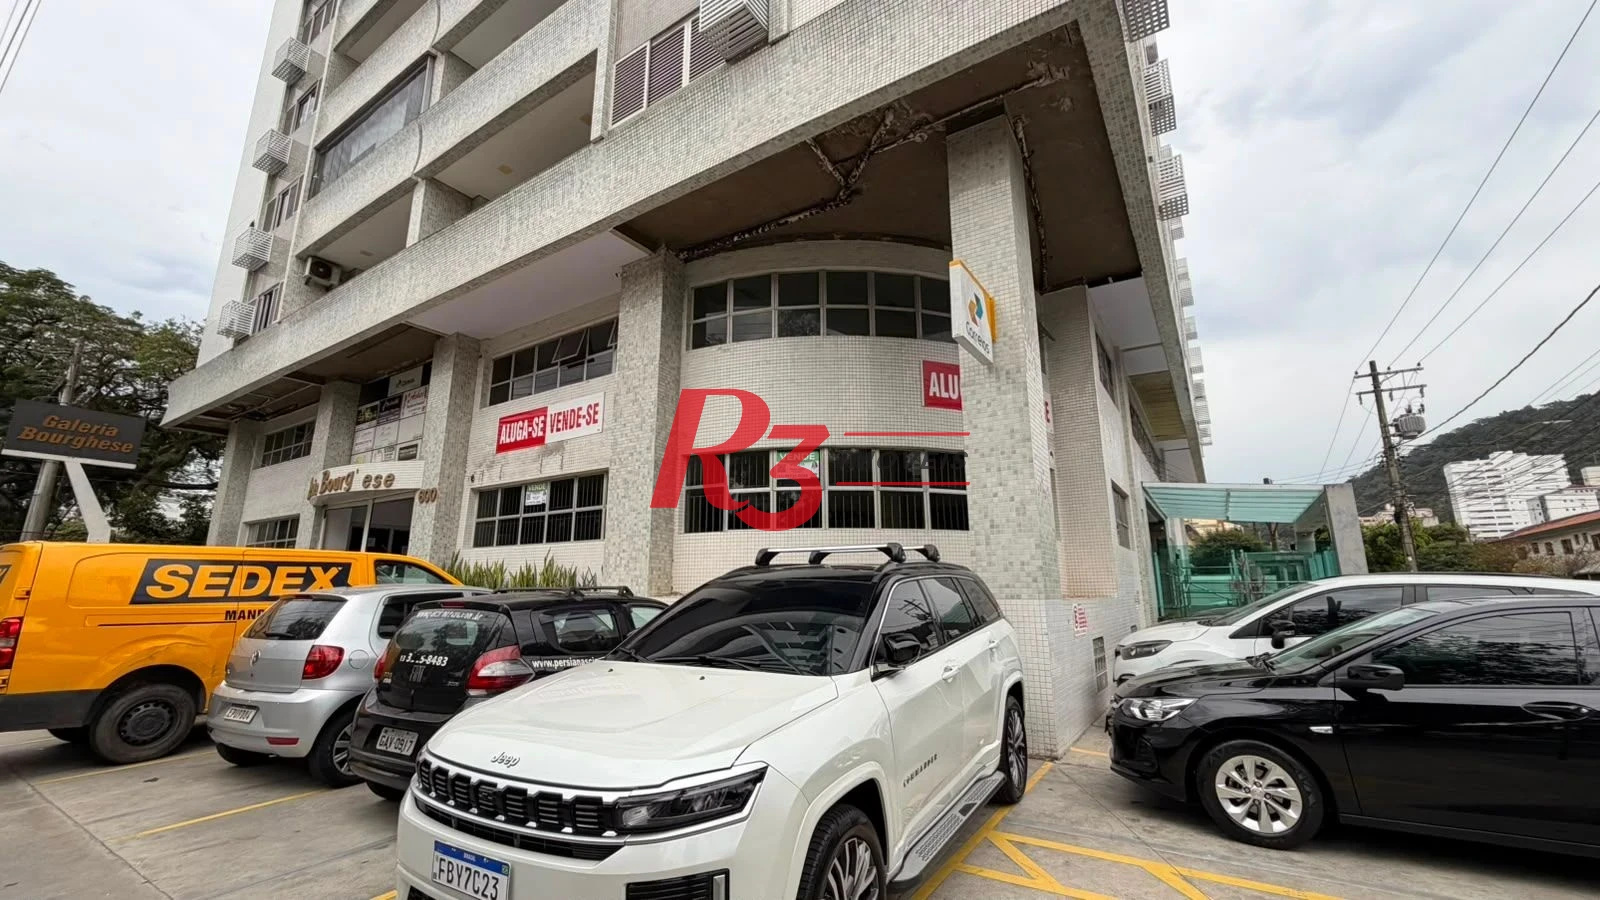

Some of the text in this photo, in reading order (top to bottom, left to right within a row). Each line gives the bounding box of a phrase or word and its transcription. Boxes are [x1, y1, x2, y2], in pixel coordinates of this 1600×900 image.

[929, 371, 963, 399] ALU
[43, 415, 119, 437] Galeria
[500, 416, 545, 445] ALUGA-SE
[550, 402, 600, 434] VENDE-SE
[17, 426, 135, 453] Bourghese
[146, 564, 340, 600] SEDEX
[491, 752, 521, 768] Jeep
[438, 857, 500, 900] FBY7C23
